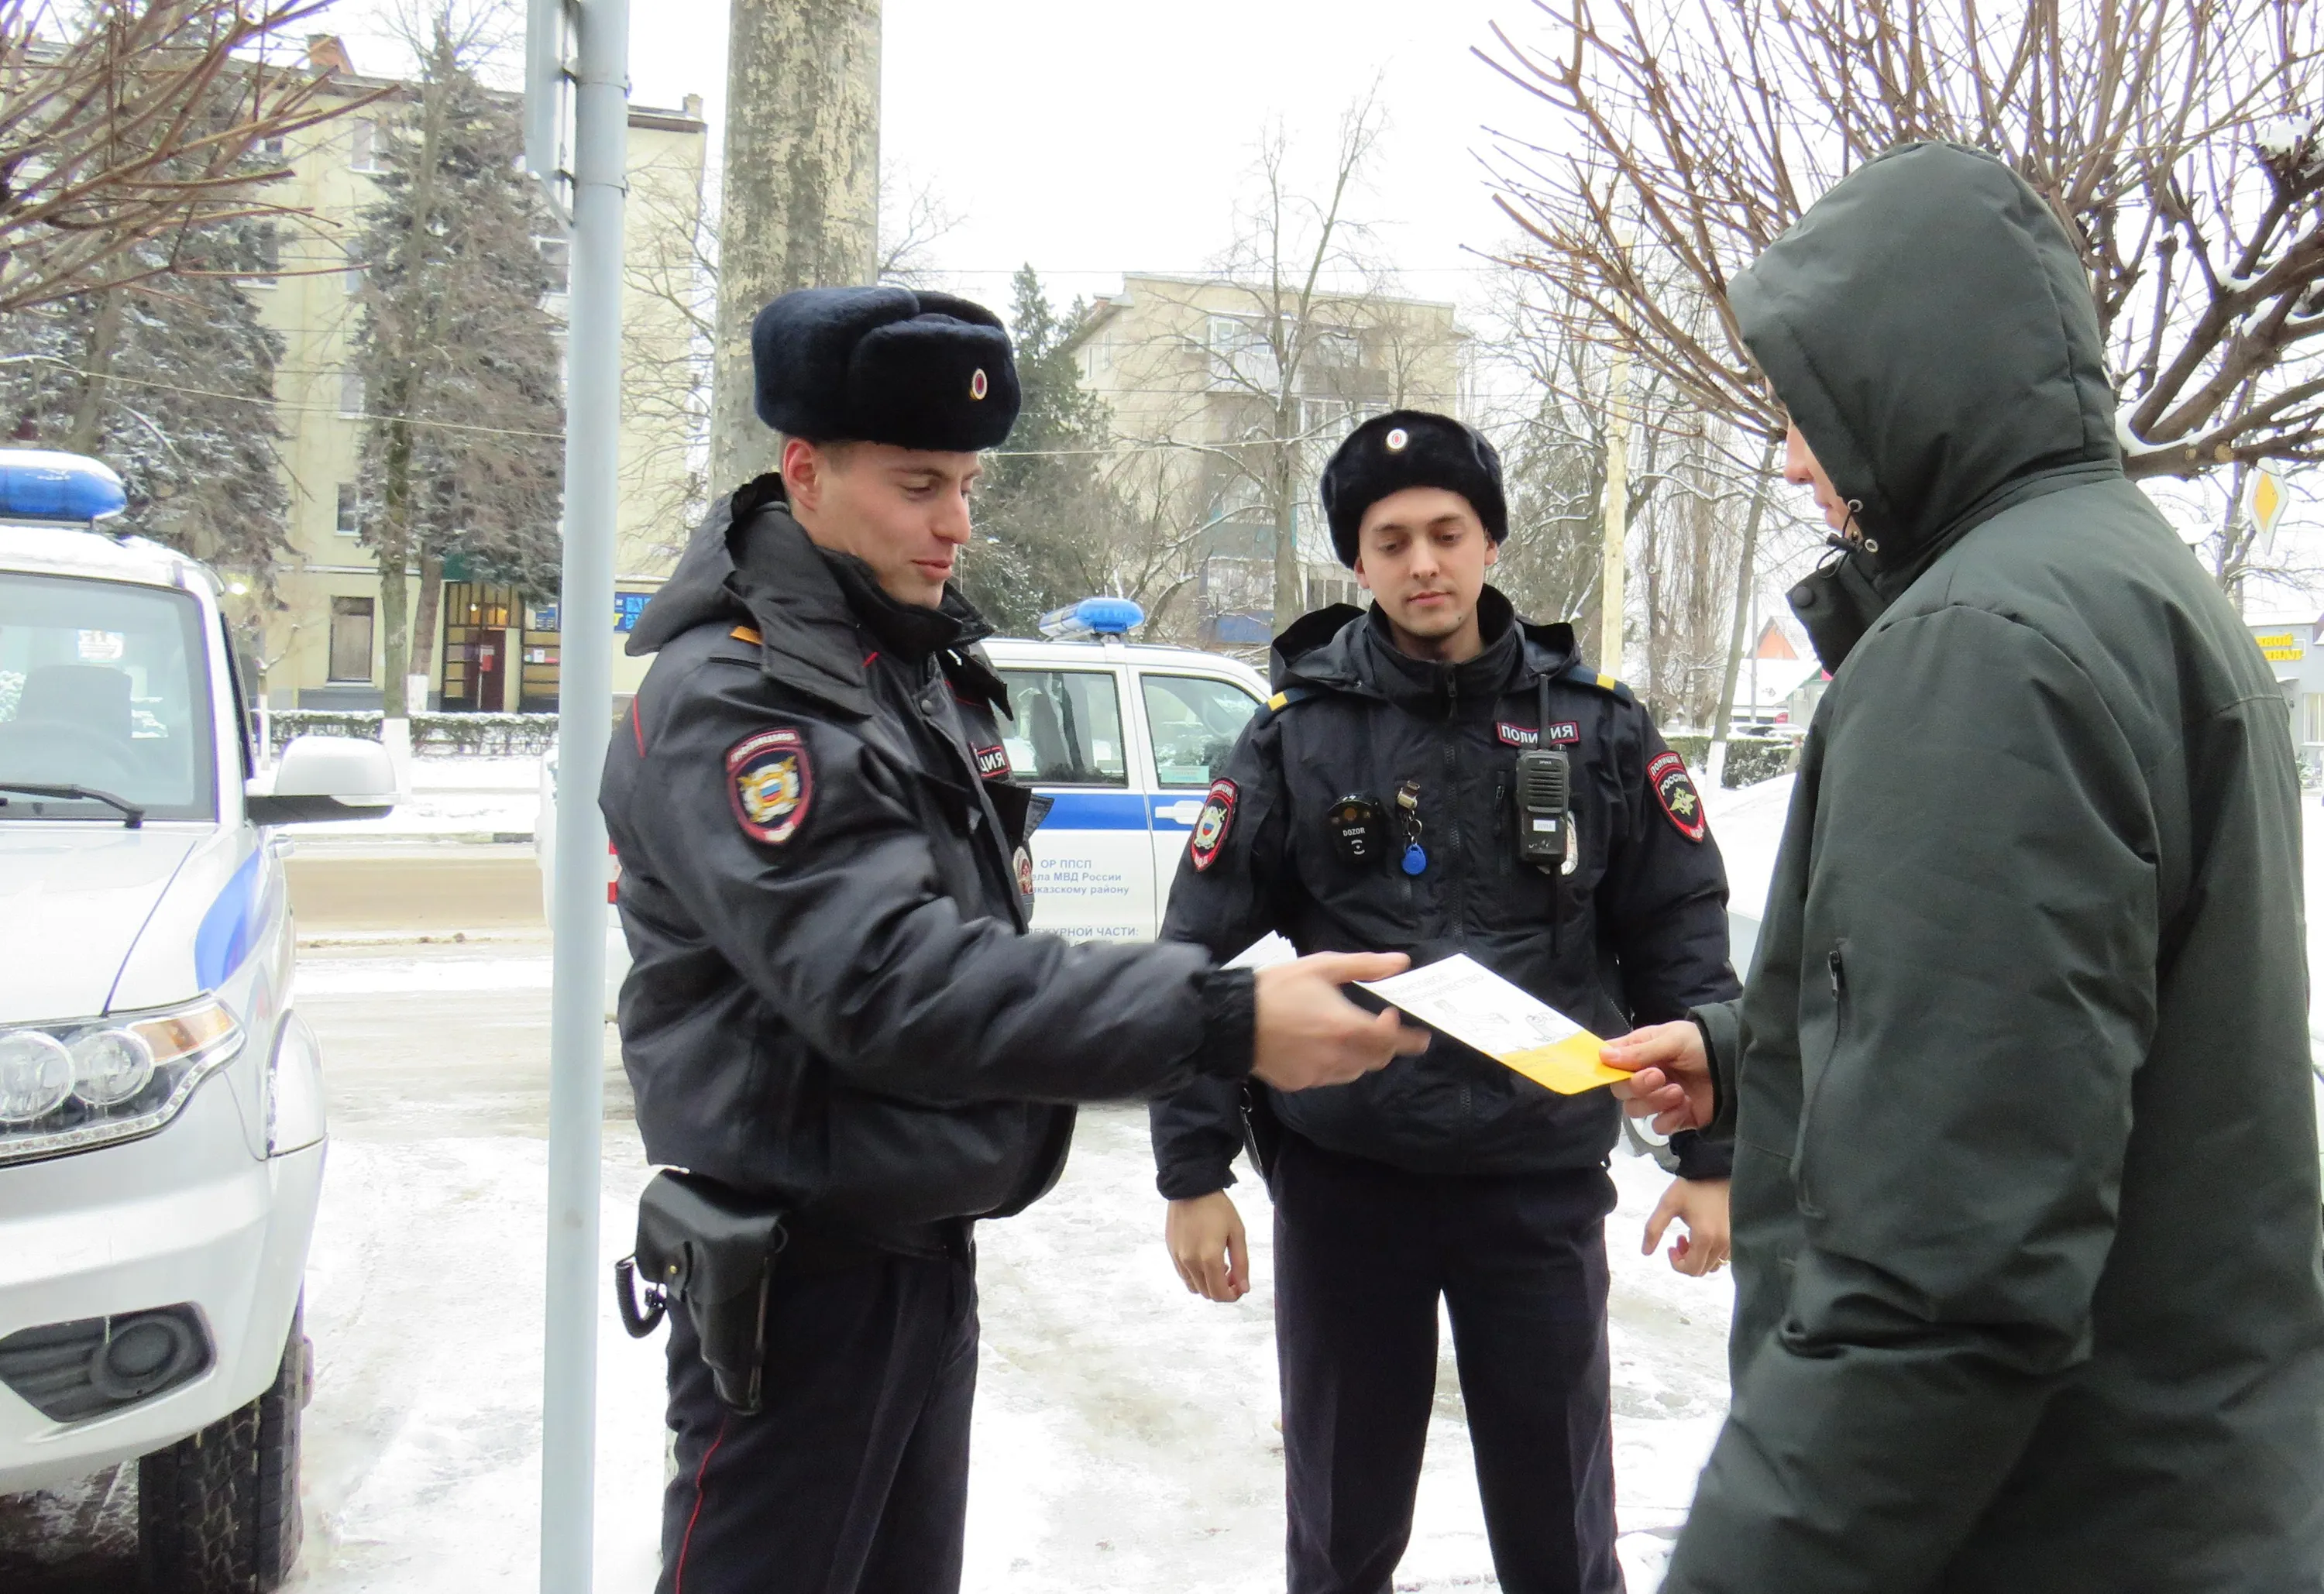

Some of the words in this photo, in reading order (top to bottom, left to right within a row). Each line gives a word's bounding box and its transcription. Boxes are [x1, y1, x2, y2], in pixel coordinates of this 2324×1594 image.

[1501, 725, 1573, 744] ПОЛИИЯ
[1659, 773, 1689, 796] РОССИЯ
[1342, 826, 1366, 837] DOZOR
[1040, 859, 1057, 868] ОР
[1060, 860, 1092, 868] ППСП
[1054, 872, 1078, 882] МВД
[1082, 872, 1122, 881] России
[1033, 886, 1087, 895] казскому
[1090, 884, 1129, 895] району
[1097, 926, 1139, 936] ЧАСТИ:
